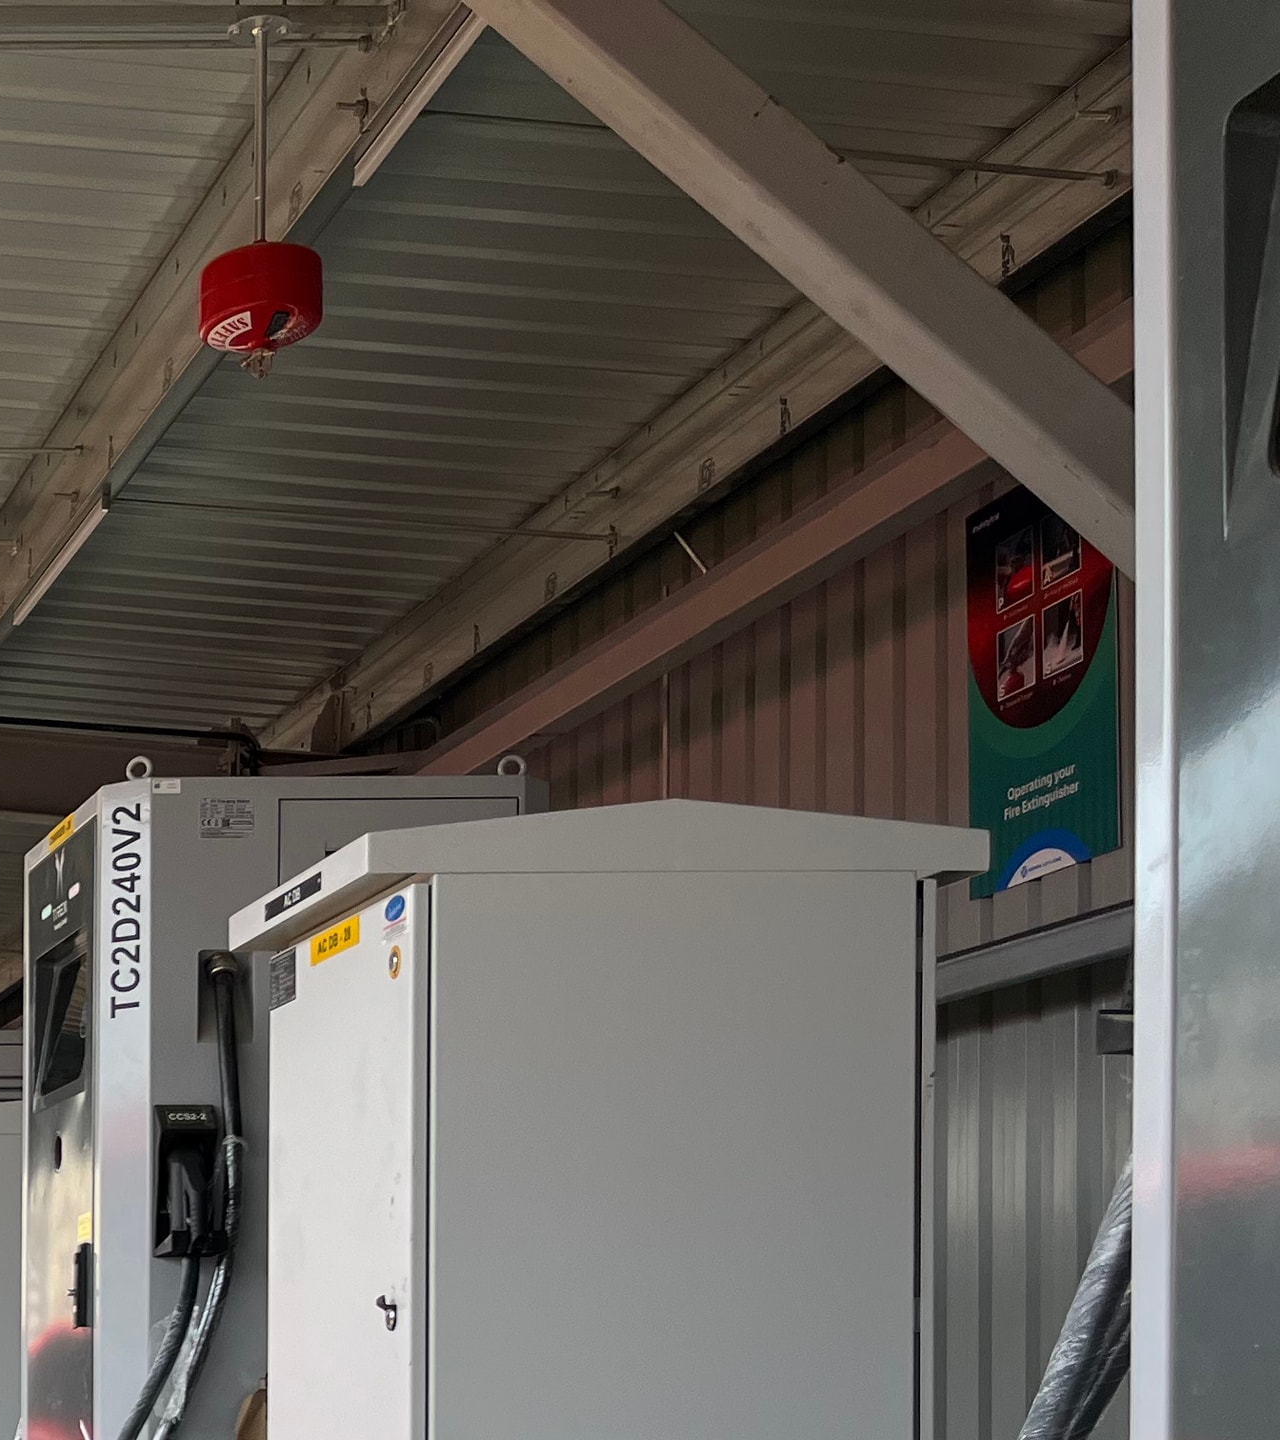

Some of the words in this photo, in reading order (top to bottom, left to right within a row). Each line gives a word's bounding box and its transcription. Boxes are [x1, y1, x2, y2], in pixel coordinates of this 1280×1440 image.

[1004, 806, 1021, 821] Fire
[1022, 781, 1080, 808] Extinguisher
[1007, 773, 1053, 800] Operating
[1053, 764, 1076, 783] your
[110, 803, 142, 1019] TC2D240V2
[317, 939, 328, 956] AC
[329, 932, 338, 950] DB
